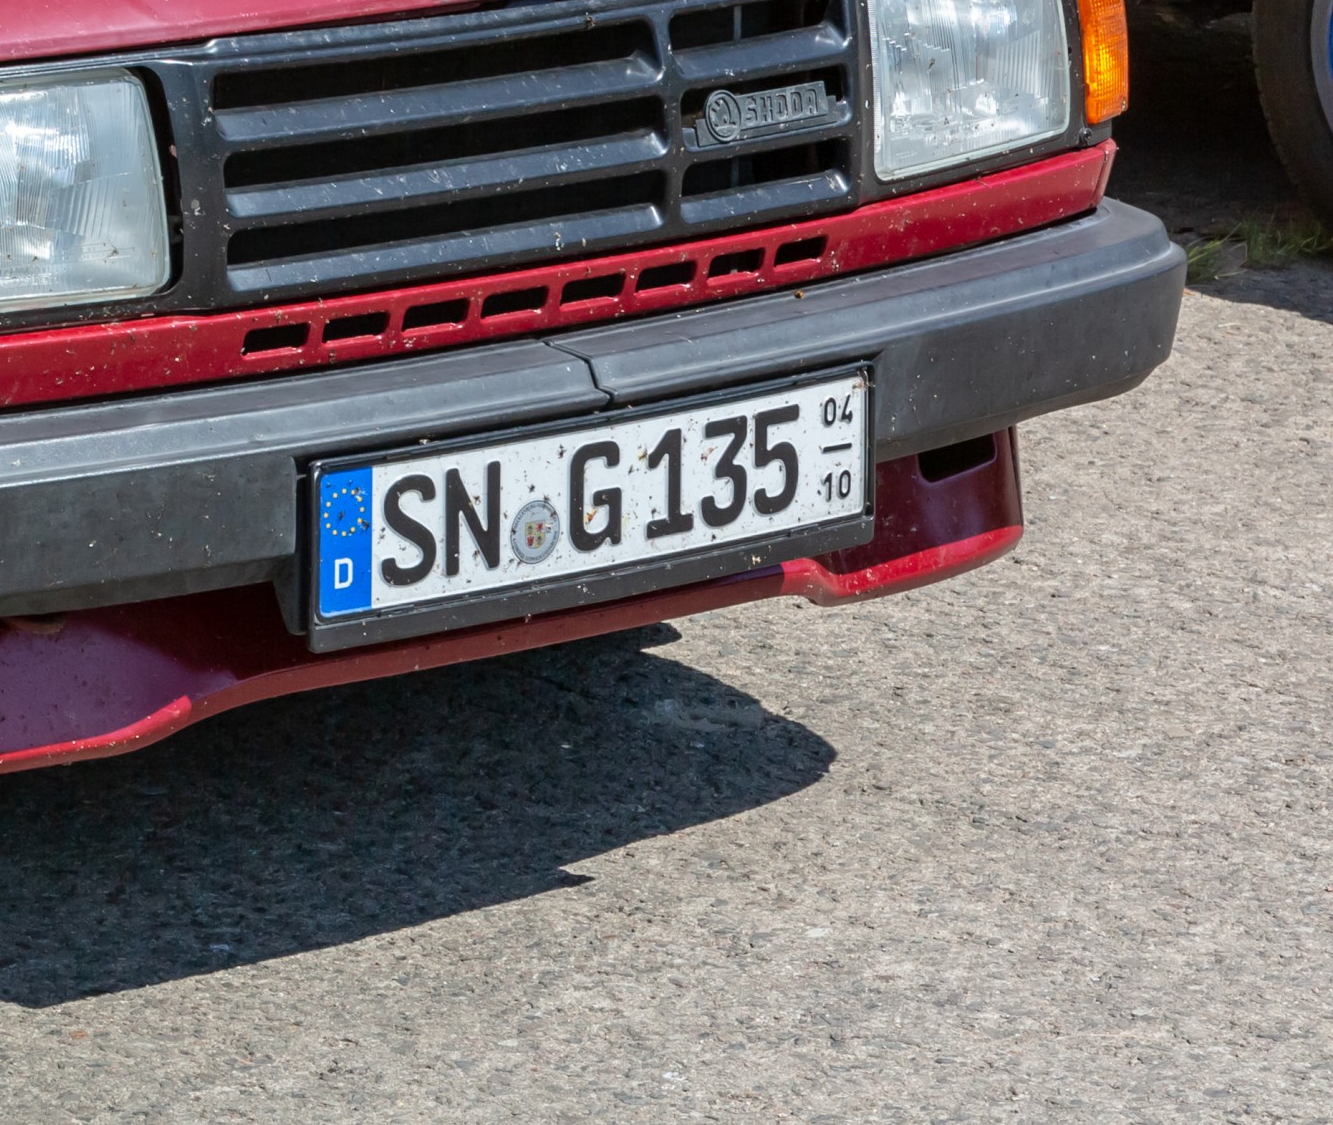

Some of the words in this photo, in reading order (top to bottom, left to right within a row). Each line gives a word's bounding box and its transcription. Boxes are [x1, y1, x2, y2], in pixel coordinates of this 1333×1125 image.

[823, 394, 854, 427] 04
[380, 460, 502, 588] SN
[568, 440, 622, 553] G
[645, 404, 800, 540] 135
[822, 469, 852, 503] 10
[334, 557, 354, 590] D
